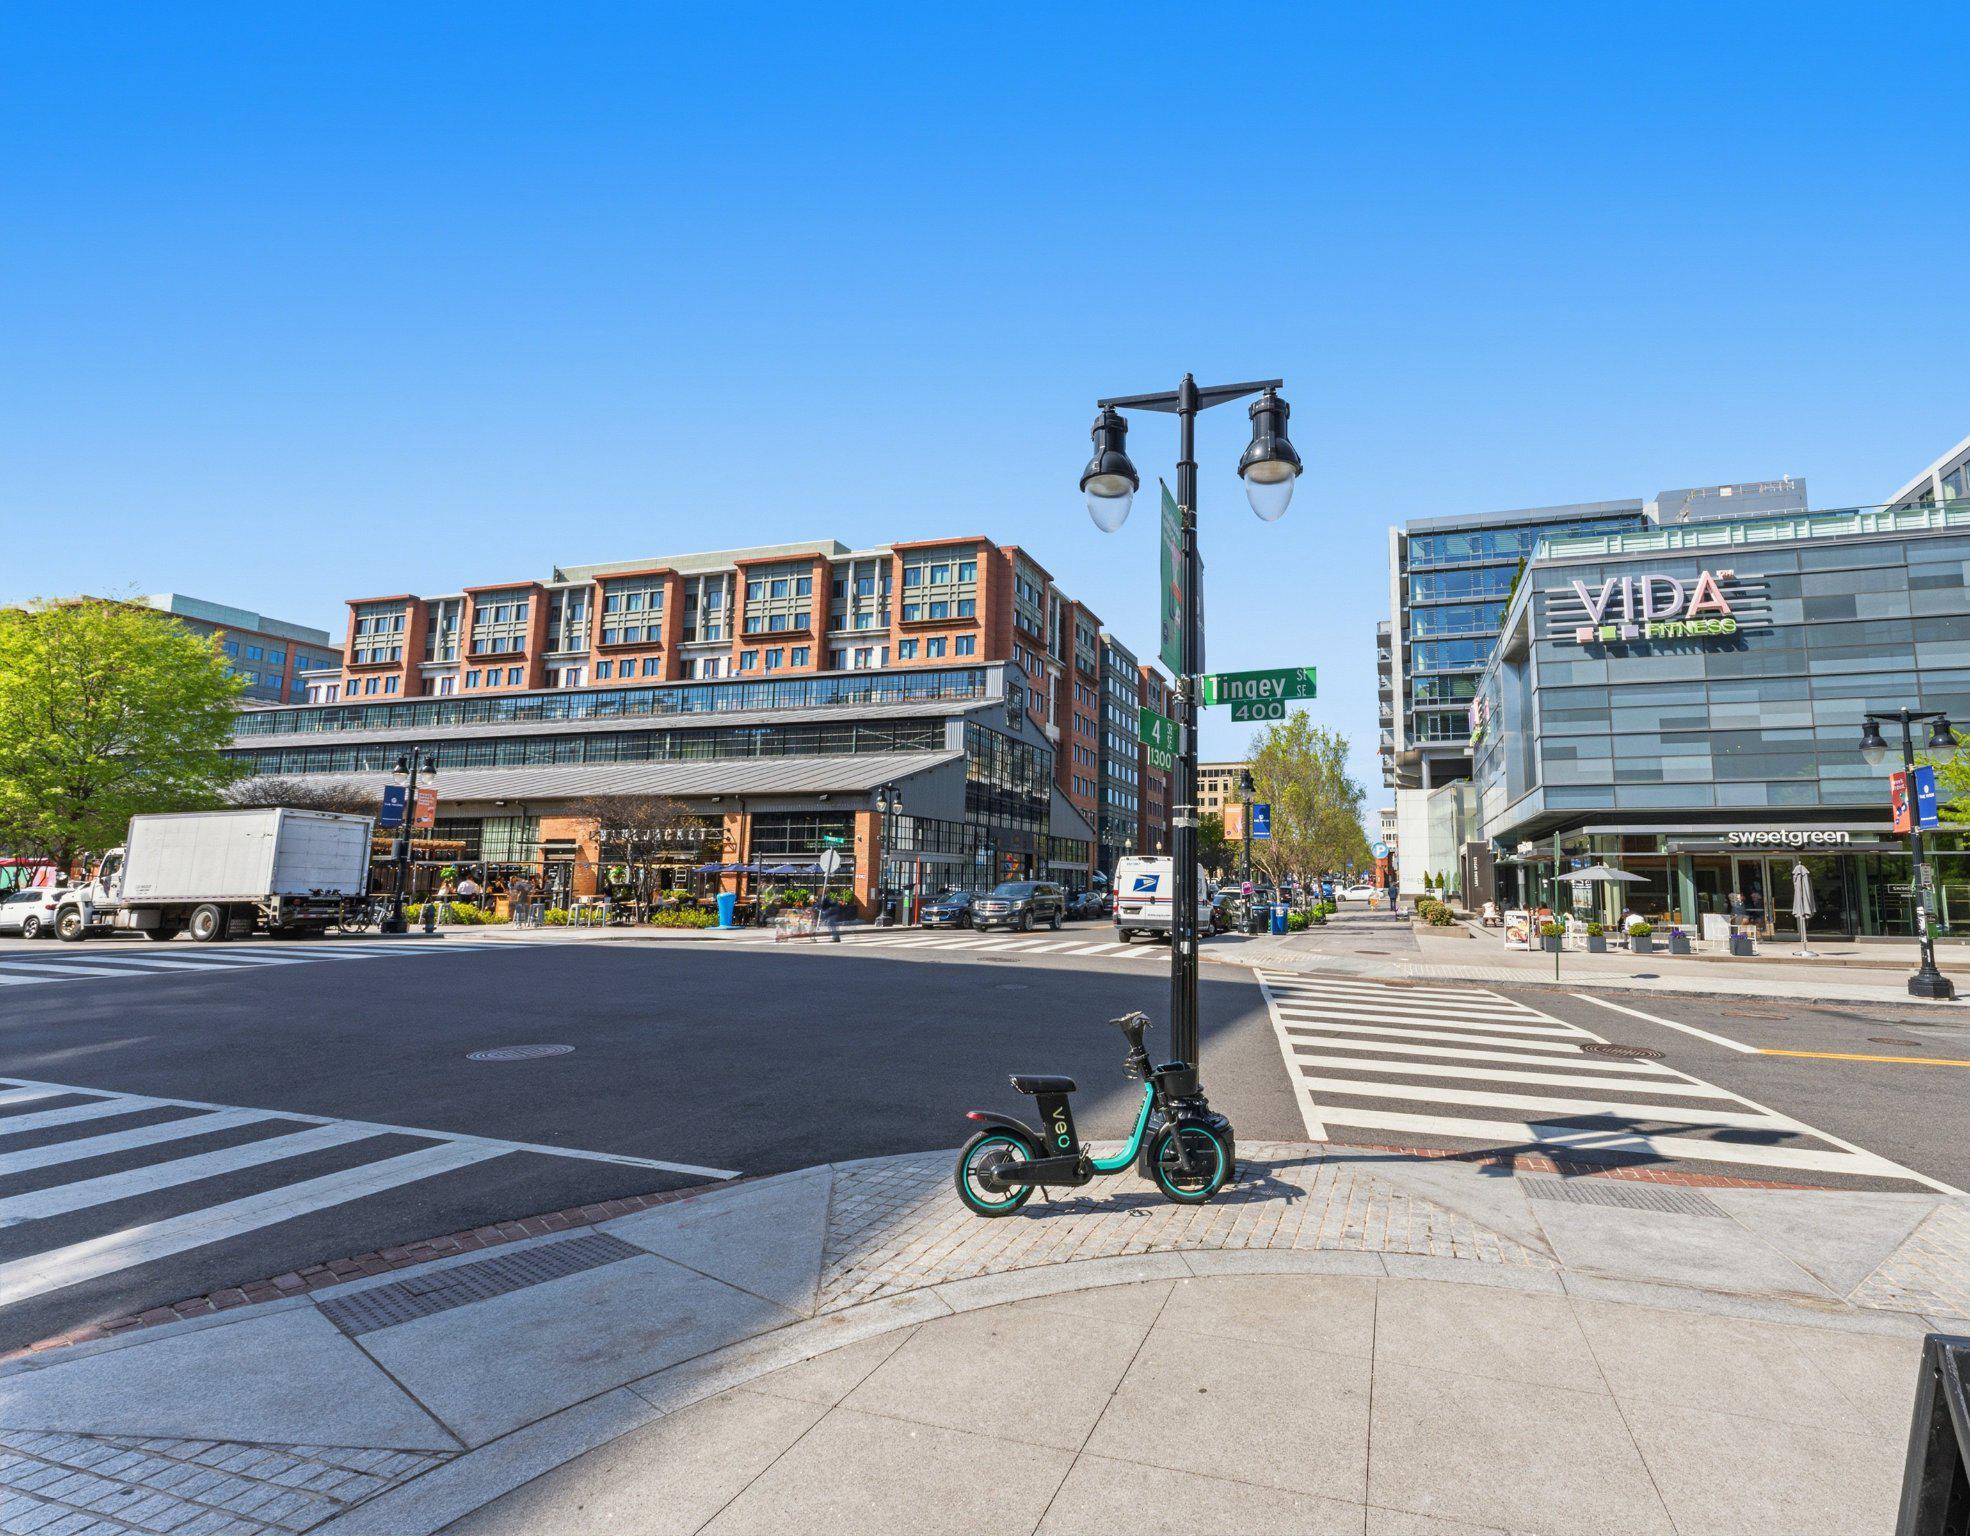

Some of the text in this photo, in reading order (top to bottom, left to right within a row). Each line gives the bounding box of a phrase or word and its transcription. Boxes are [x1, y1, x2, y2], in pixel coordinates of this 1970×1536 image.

[1572, 570, 1732, 625] VIDA
[1645, 618, 1737, 639] FITNESS
[1209, 676, 1286, 699] Tingey
[1296, 684, 1307, 697] SE
[1235, 702, 1283, 720] 400
[1151, 719, 1161, 744] 4
[1150, 747, 1172, 769] 1300
[1728, 829, 1850, 846] sweetgreen
[1052, 1106, 1070, 1148] veo
